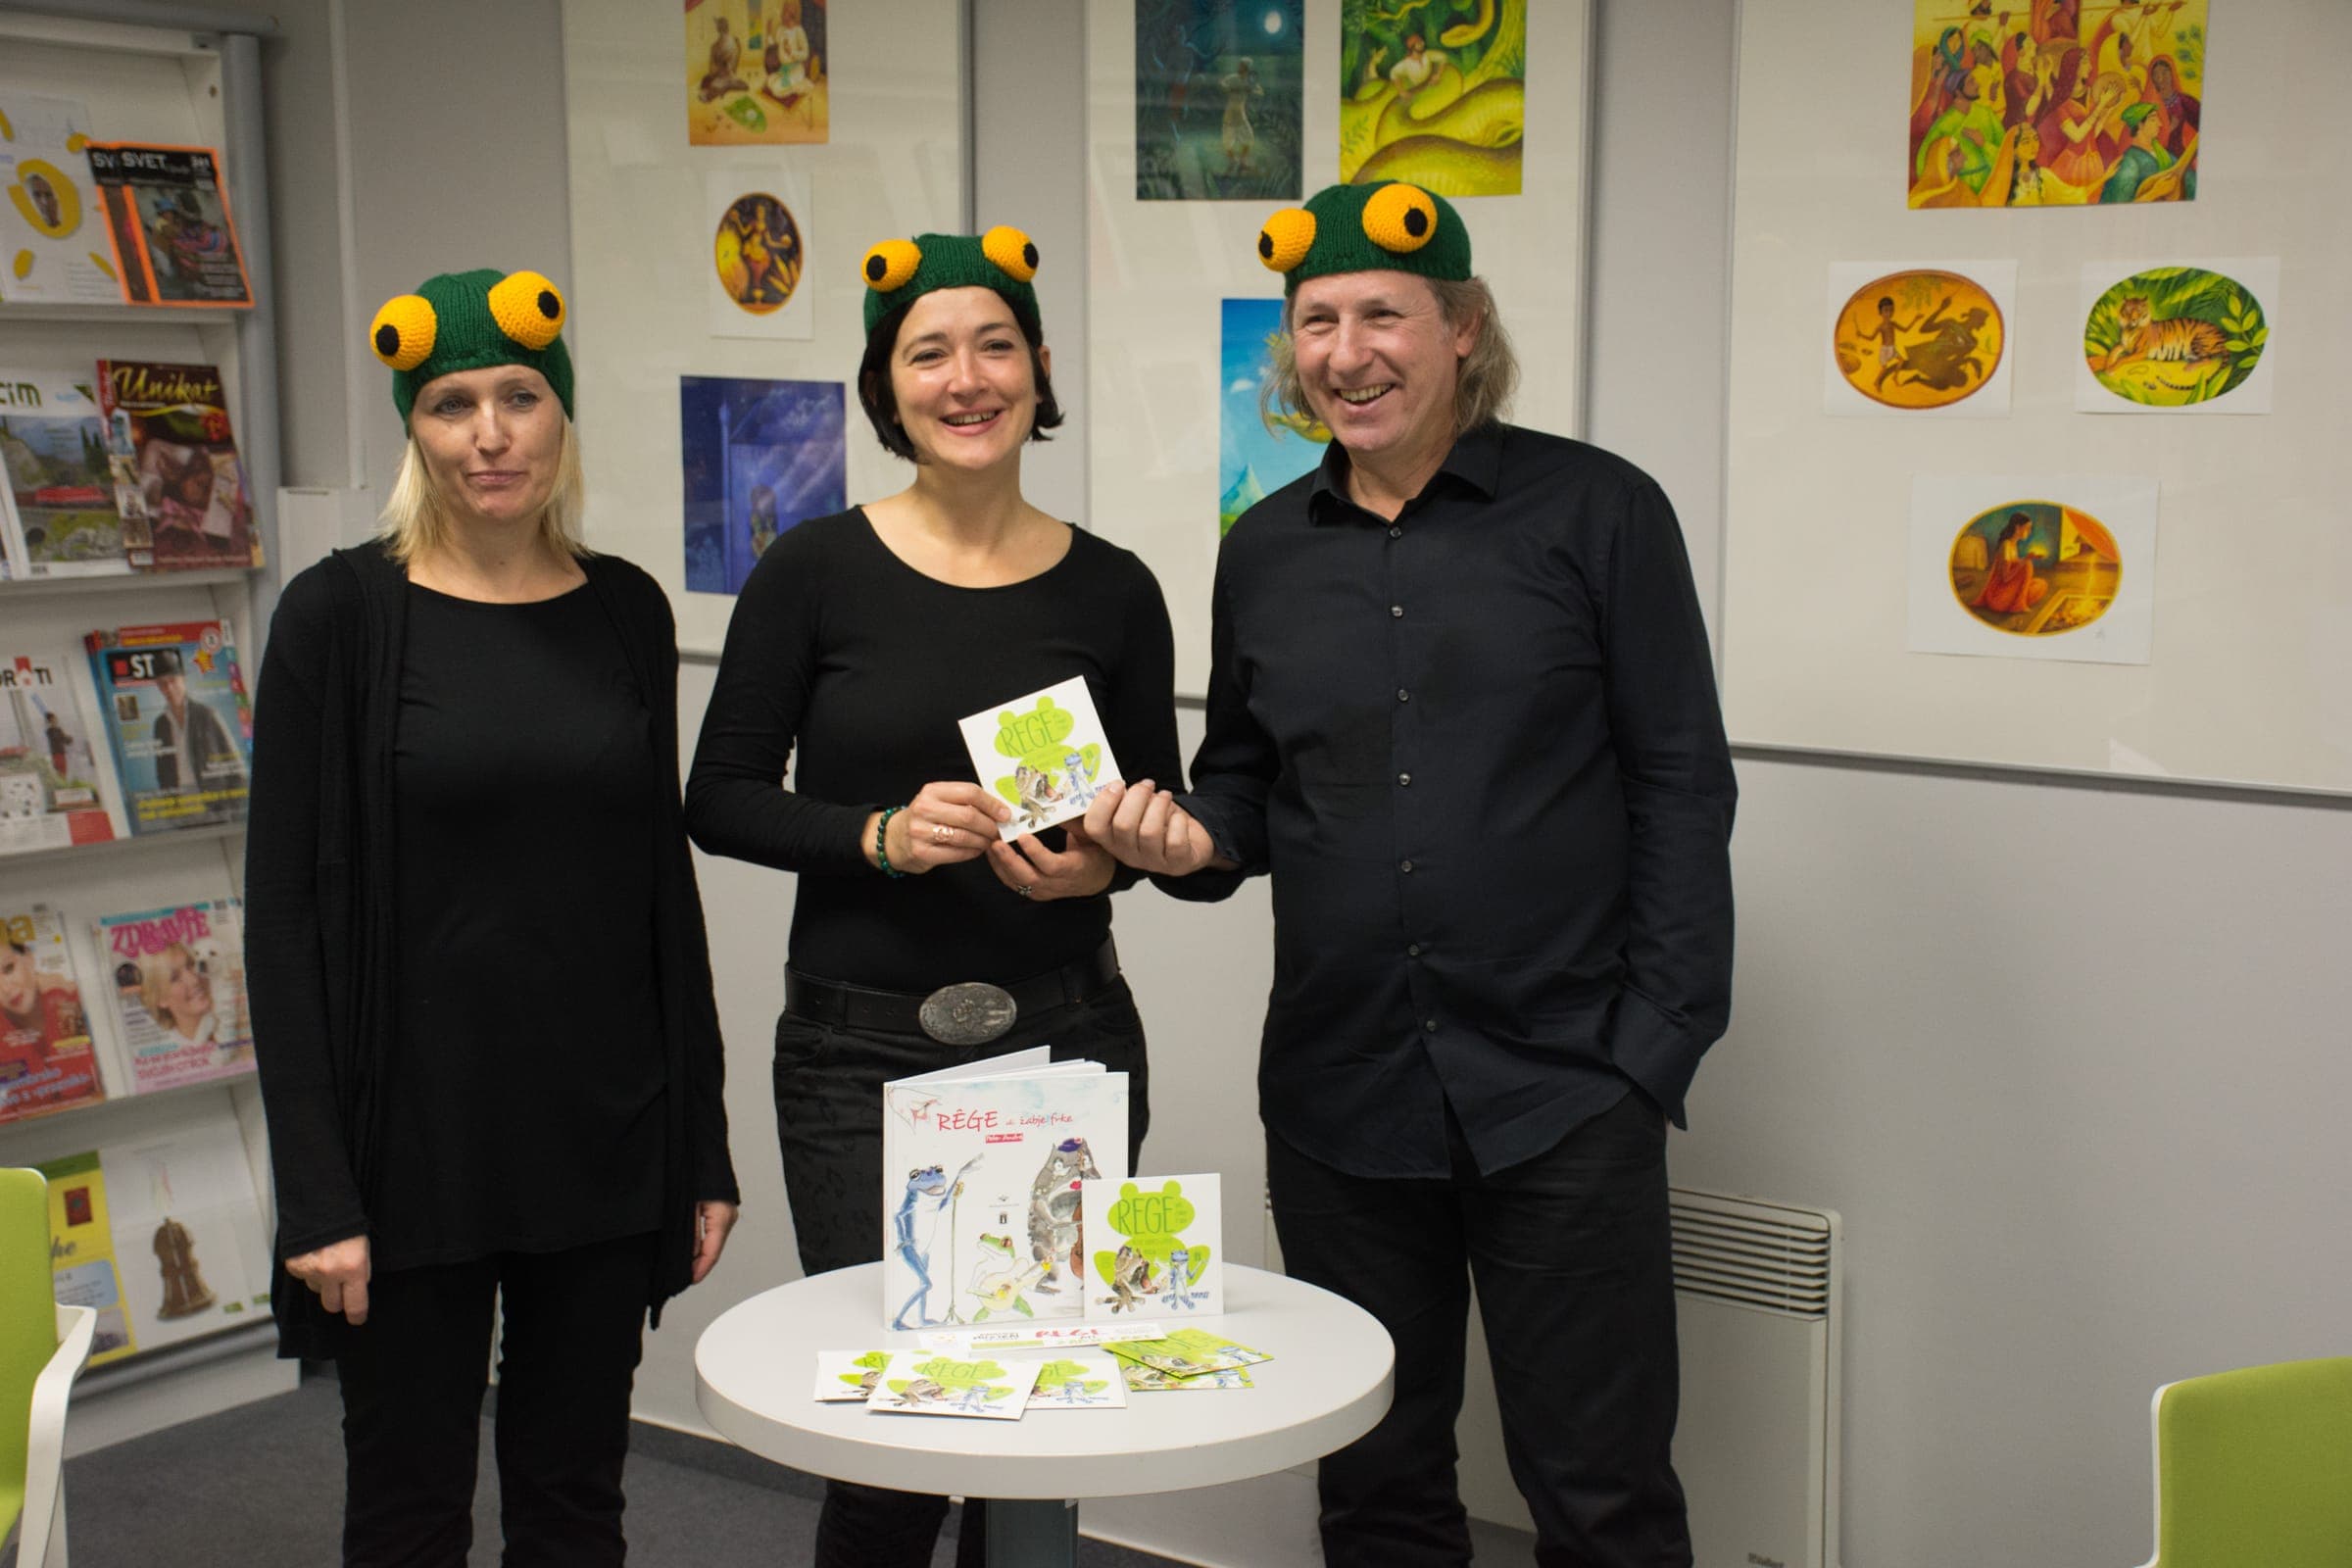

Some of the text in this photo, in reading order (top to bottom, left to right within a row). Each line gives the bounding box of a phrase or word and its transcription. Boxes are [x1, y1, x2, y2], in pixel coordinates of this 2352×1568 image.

[121, 152, 168, 170] SVET
[113, 368, 219, 403] Unikat
[1000, 710, 1060, 758] REGE
[1117, 1196, 1176, 1236] REGE
